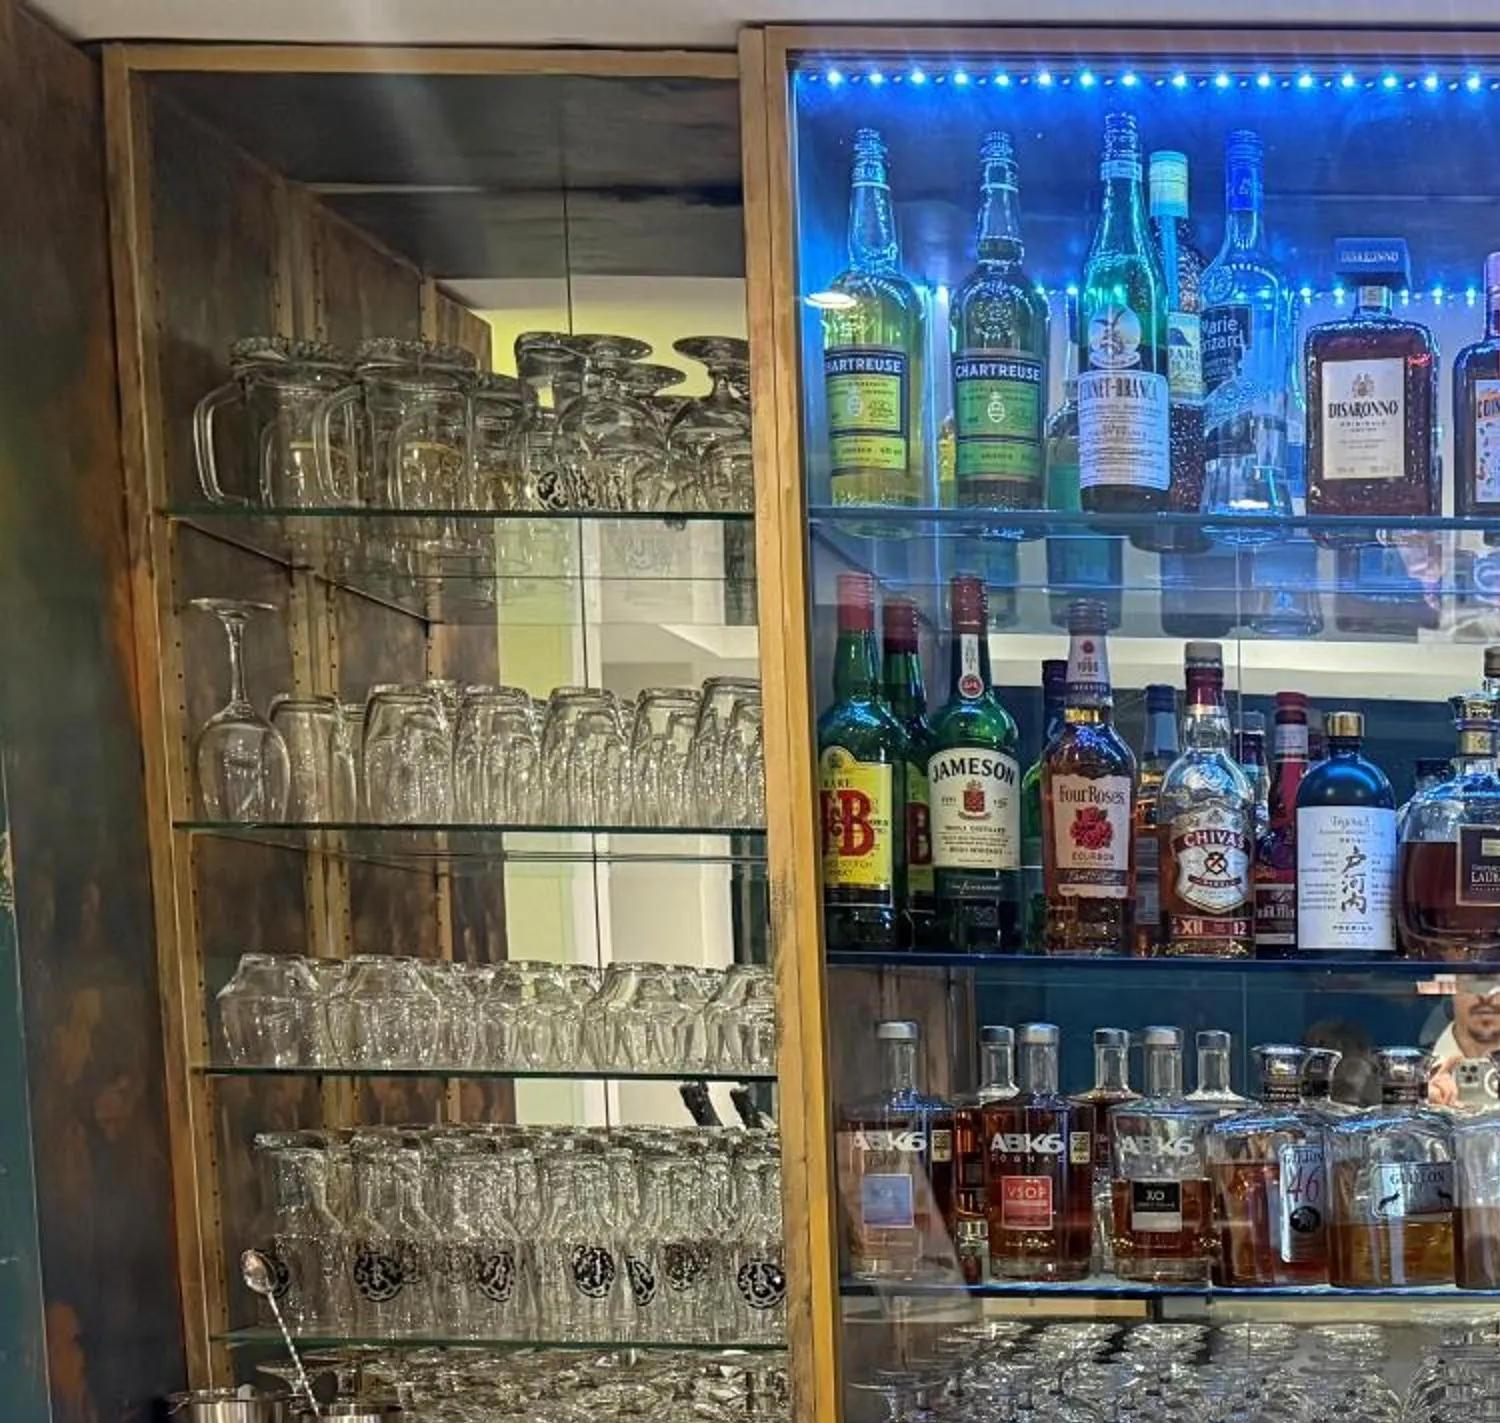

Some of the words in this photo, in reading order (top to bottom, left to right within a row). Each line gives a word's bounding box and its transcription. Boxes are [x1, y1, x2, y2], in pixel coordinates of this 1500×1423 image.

[824, 358, 902, 373] HARTREUSE
[955, 361, 1041, 382] CHARTREUSE
[1328, 399, 1399, 419] DISARONNO
[933, 757, 1016, 785] JAMESON
[1058, 784, 1087, 804] Four
[1088, 784, 1126, 805] Roses
[1183, 830, 1246, 849] CHIVAS
[852, 1130, 927, 1152] ABK6
[991, 1132, 1066, 1153] ABK6
[1121, 1135, 1195, 1157] ABK6
